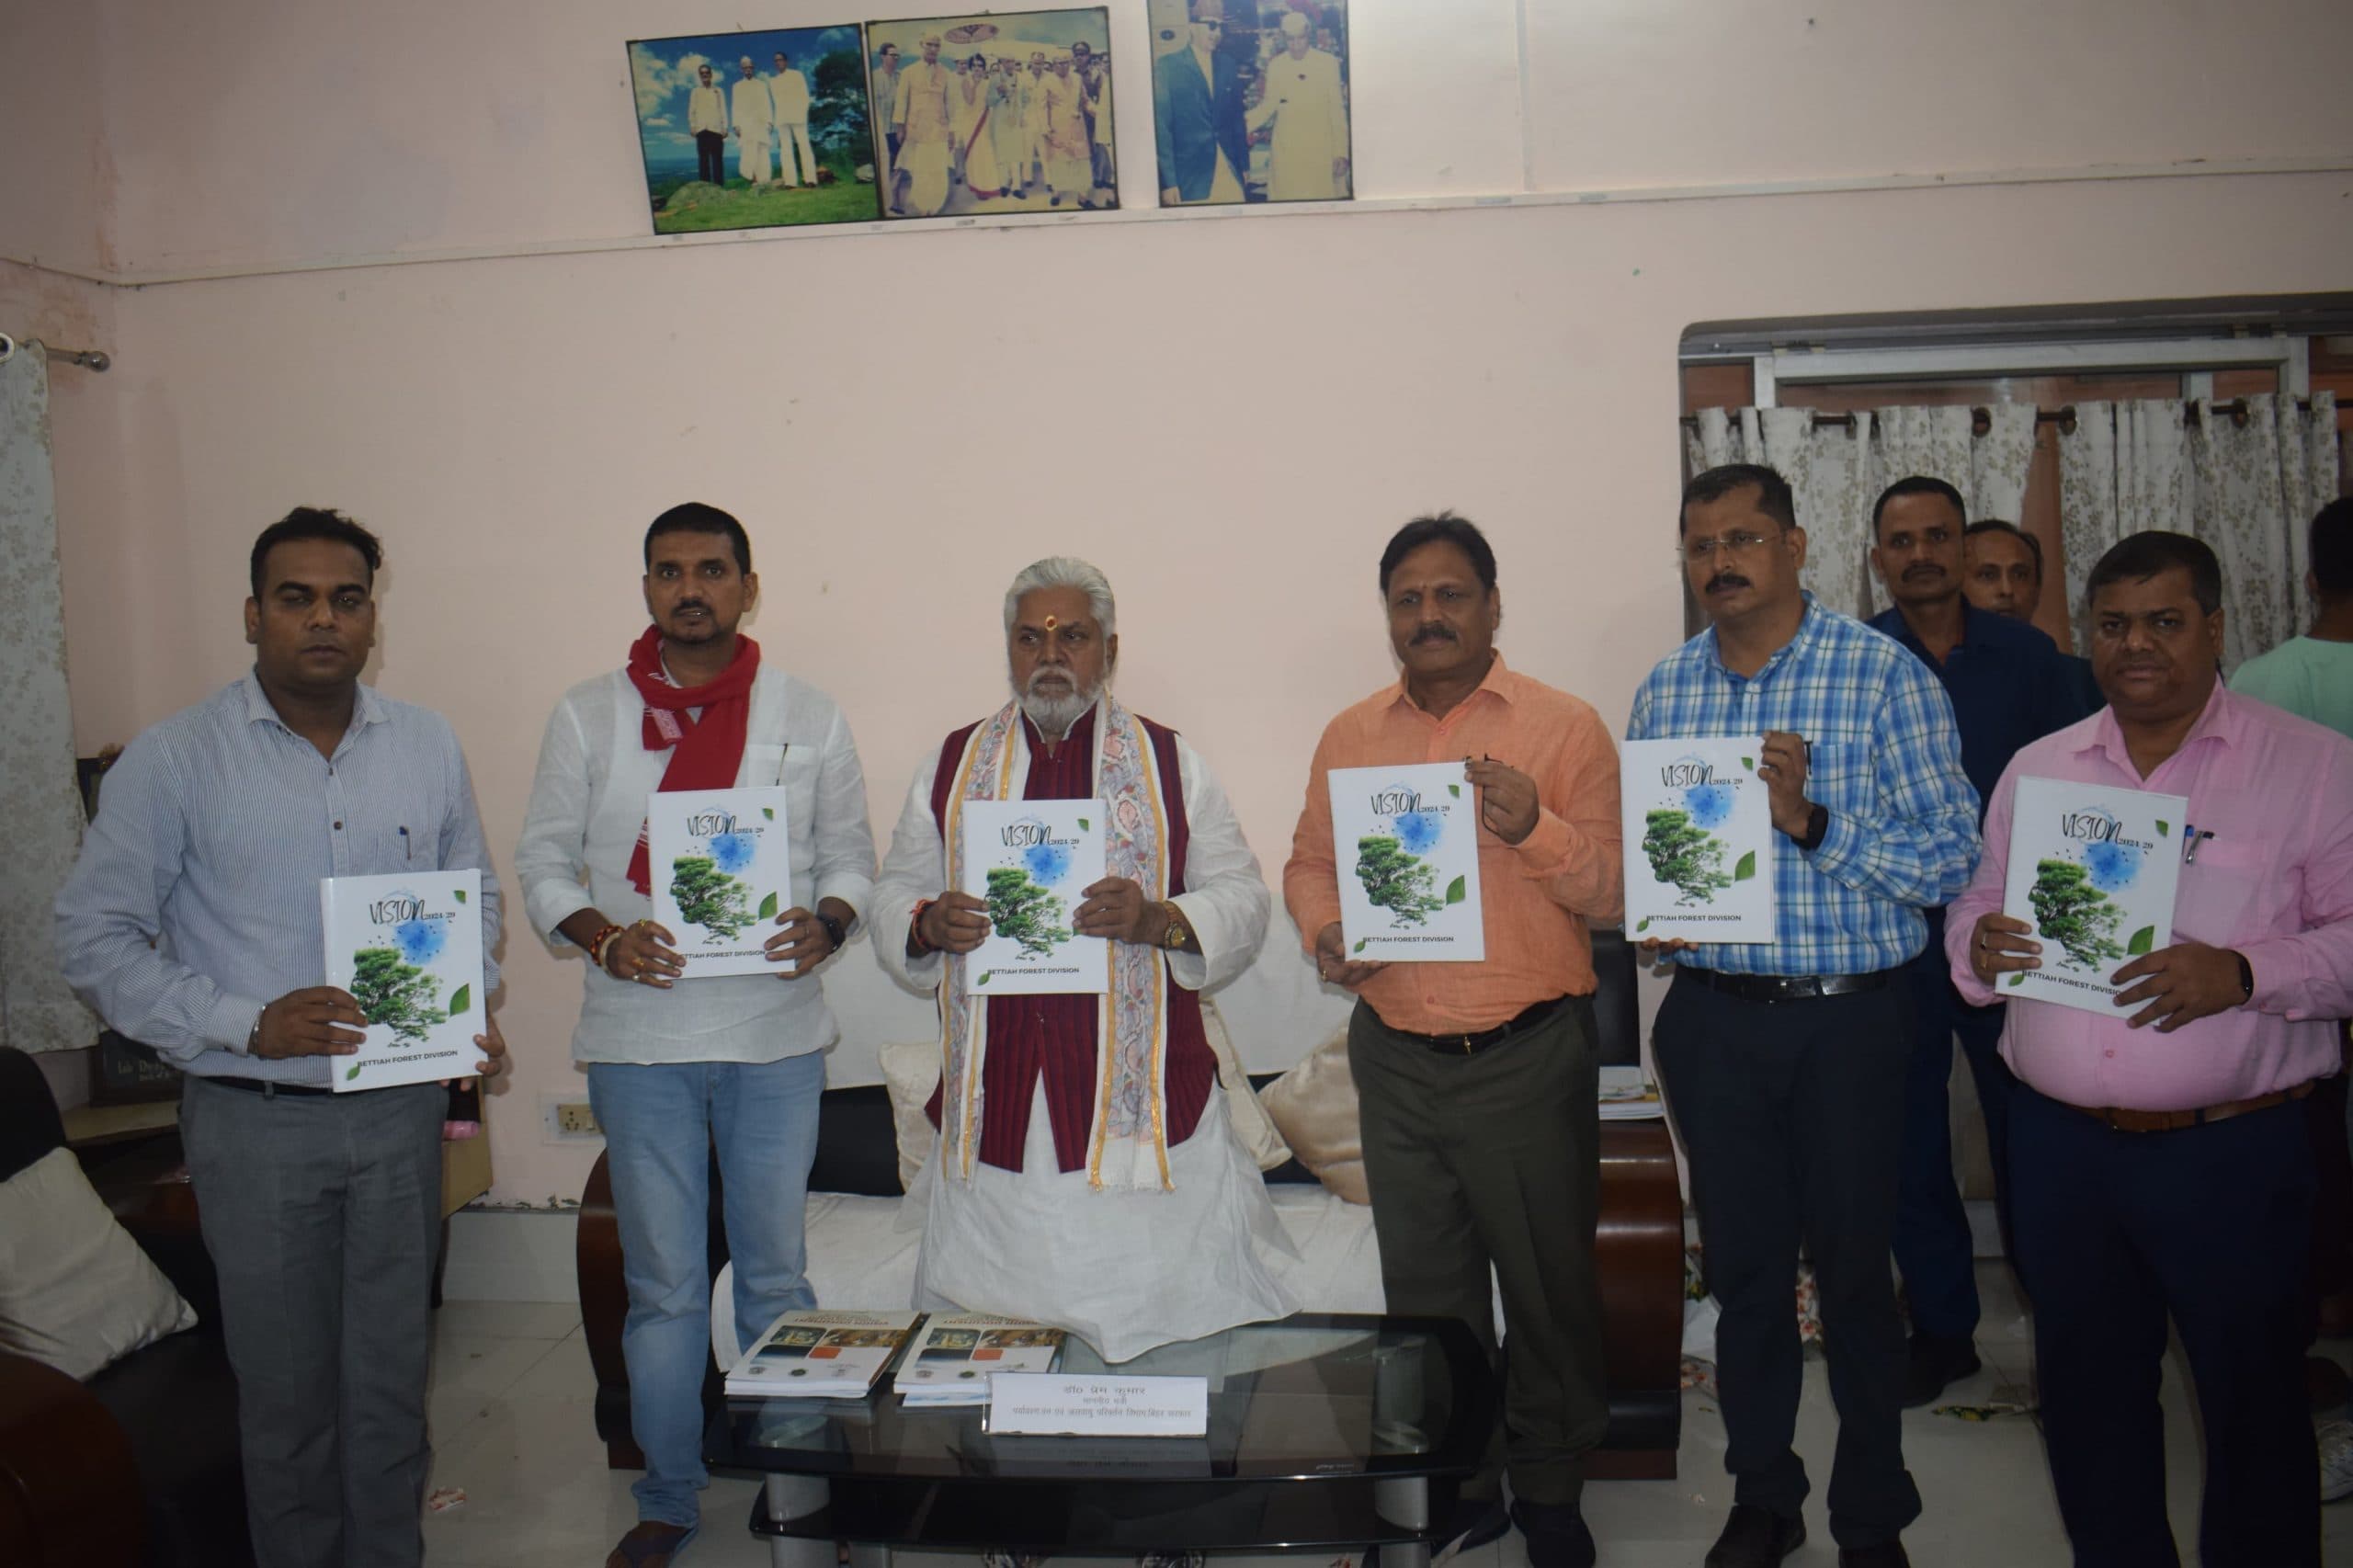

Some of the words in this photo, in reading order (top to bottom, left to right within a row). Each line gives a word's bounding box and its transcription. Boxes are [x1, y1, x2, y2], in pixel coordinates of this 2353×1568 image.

[706, 950, 733, 959] FOREST
[2022, 970, 2057, 983] BETTIAH
[2058, 977, 2089, 990] FOREST
[357, 1057, 391, 1067] BETTIAH
[392, 1054, 423, 1063] FOREST
[424, 1050, 458, 1060] DIVISION
